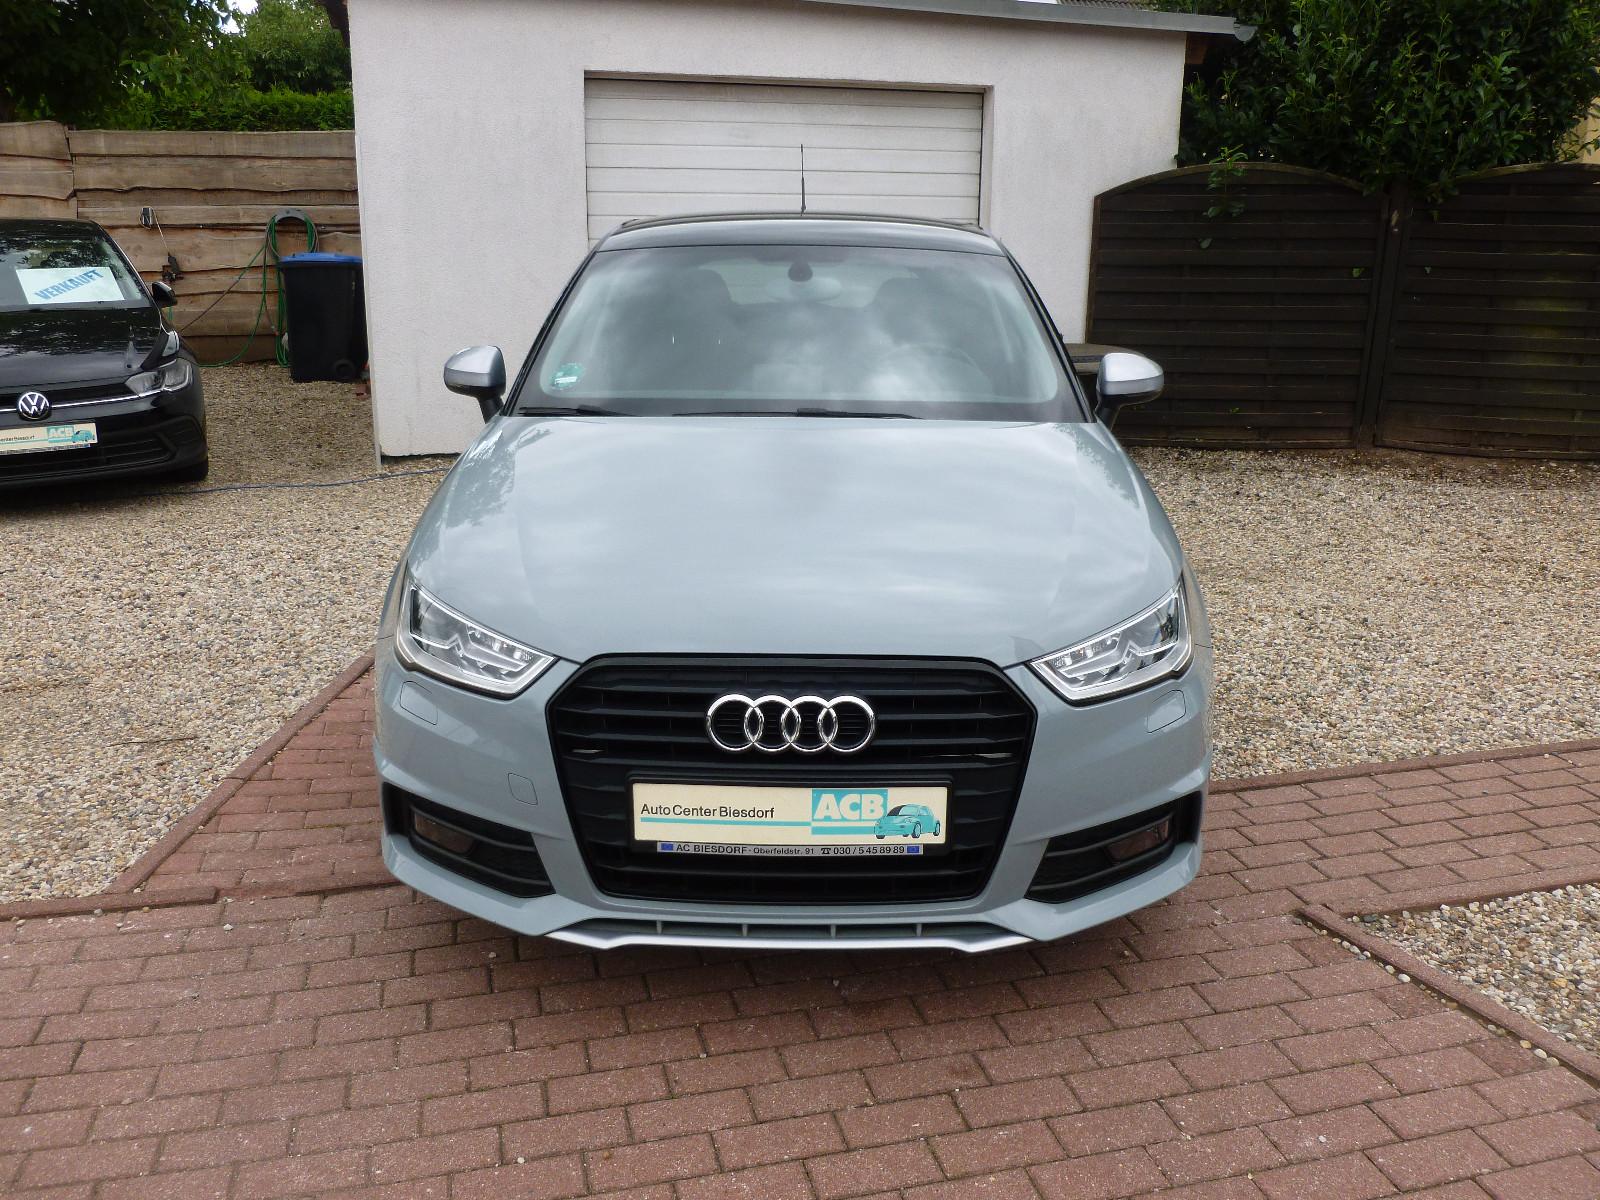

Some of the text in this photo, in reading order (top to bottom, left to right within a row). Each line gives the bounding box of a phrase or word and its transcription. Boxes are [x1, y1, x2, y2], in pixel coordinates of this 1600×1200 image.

[34, 269, 104, 300] VERKAUFT
[640, 803, 775, 819] Auto Center Biesdorf
[813, 793, 885, 820] ACB
[676, 844, 690, 852] AC
[693, 844, 748, 855] BIESDORF
[753, 846, 803, 855] Oberfeldstr.
[805, 847, 815, 855] 91
